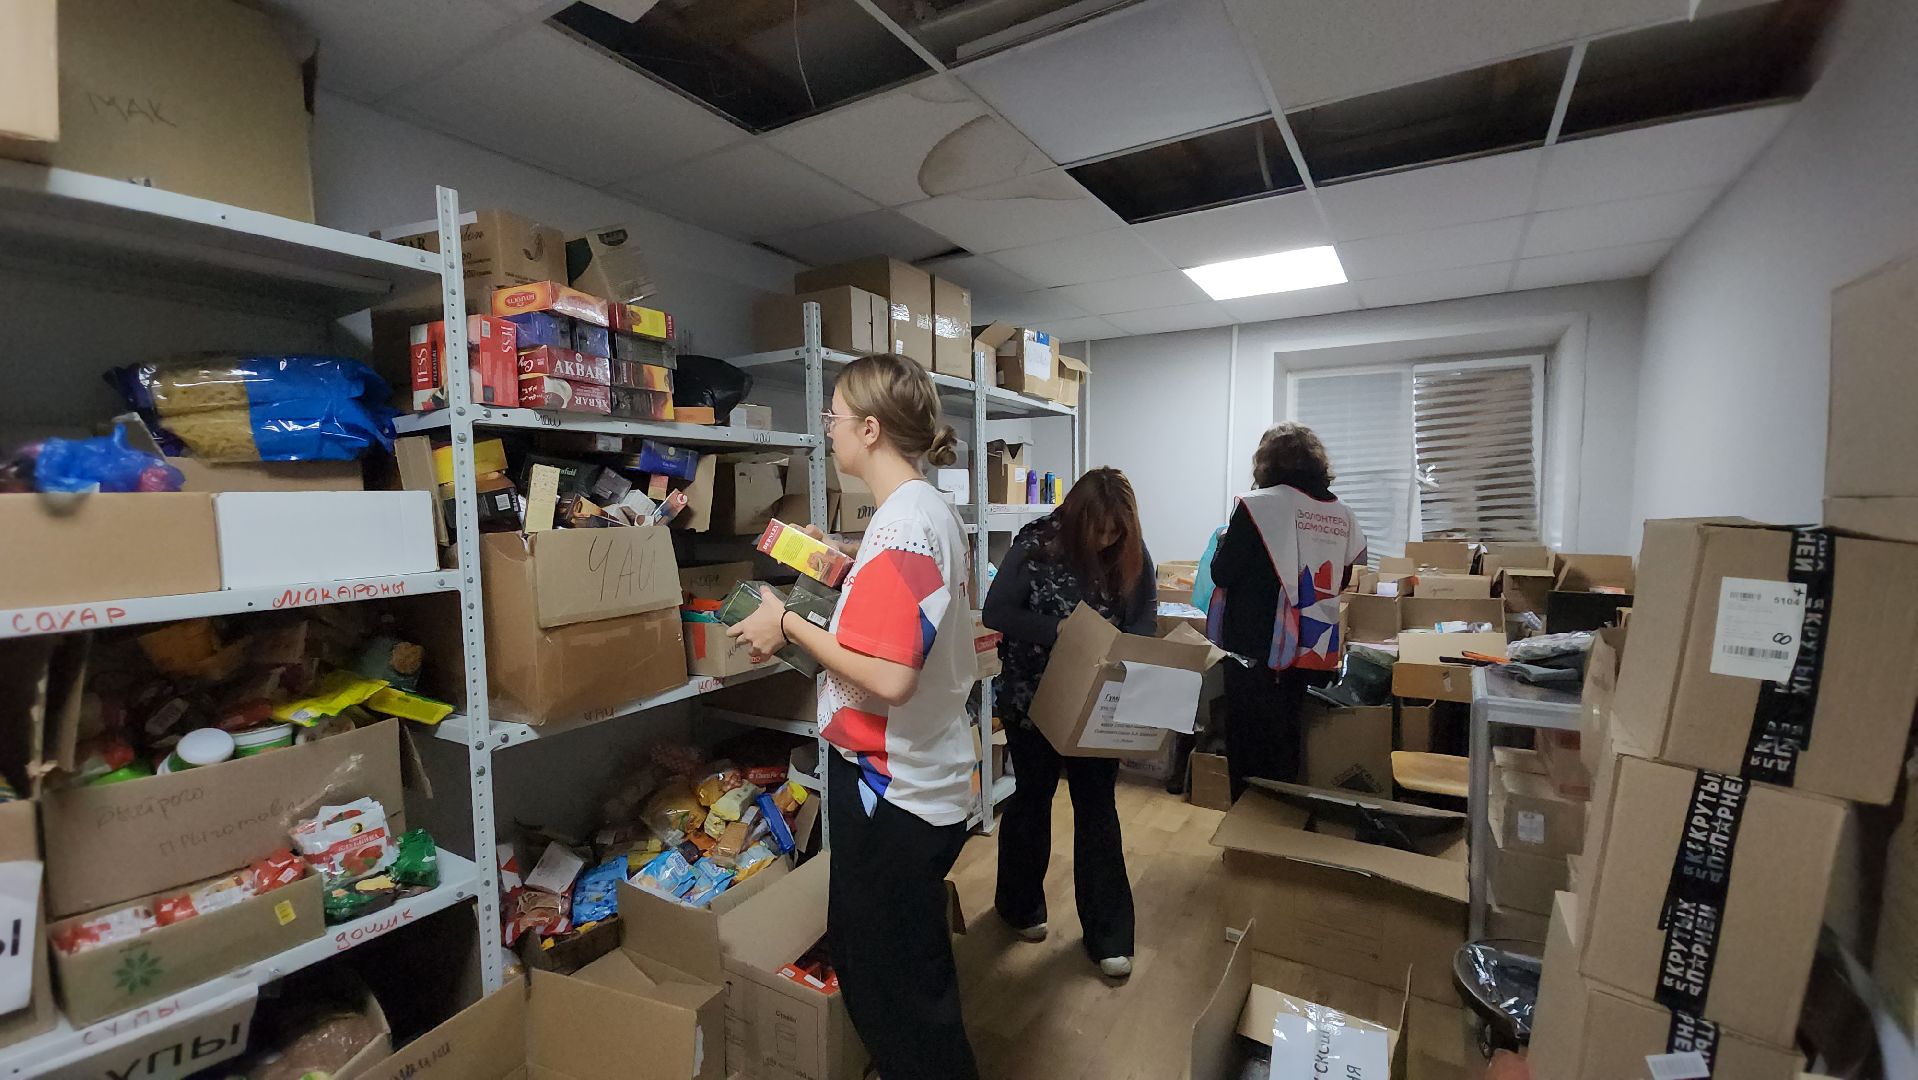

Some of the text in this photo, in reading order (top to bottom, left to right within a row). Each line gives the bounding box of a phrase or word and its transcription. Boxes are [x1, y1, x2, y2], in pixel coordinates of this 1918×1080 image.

[553, 359, 606, 381] AKBAR
[588, 534, 658, 601] ЧАЙ
[1688, 771, 1722, 841] КРУТЫ
[105, 1023, 240, 1080] УПЫ
